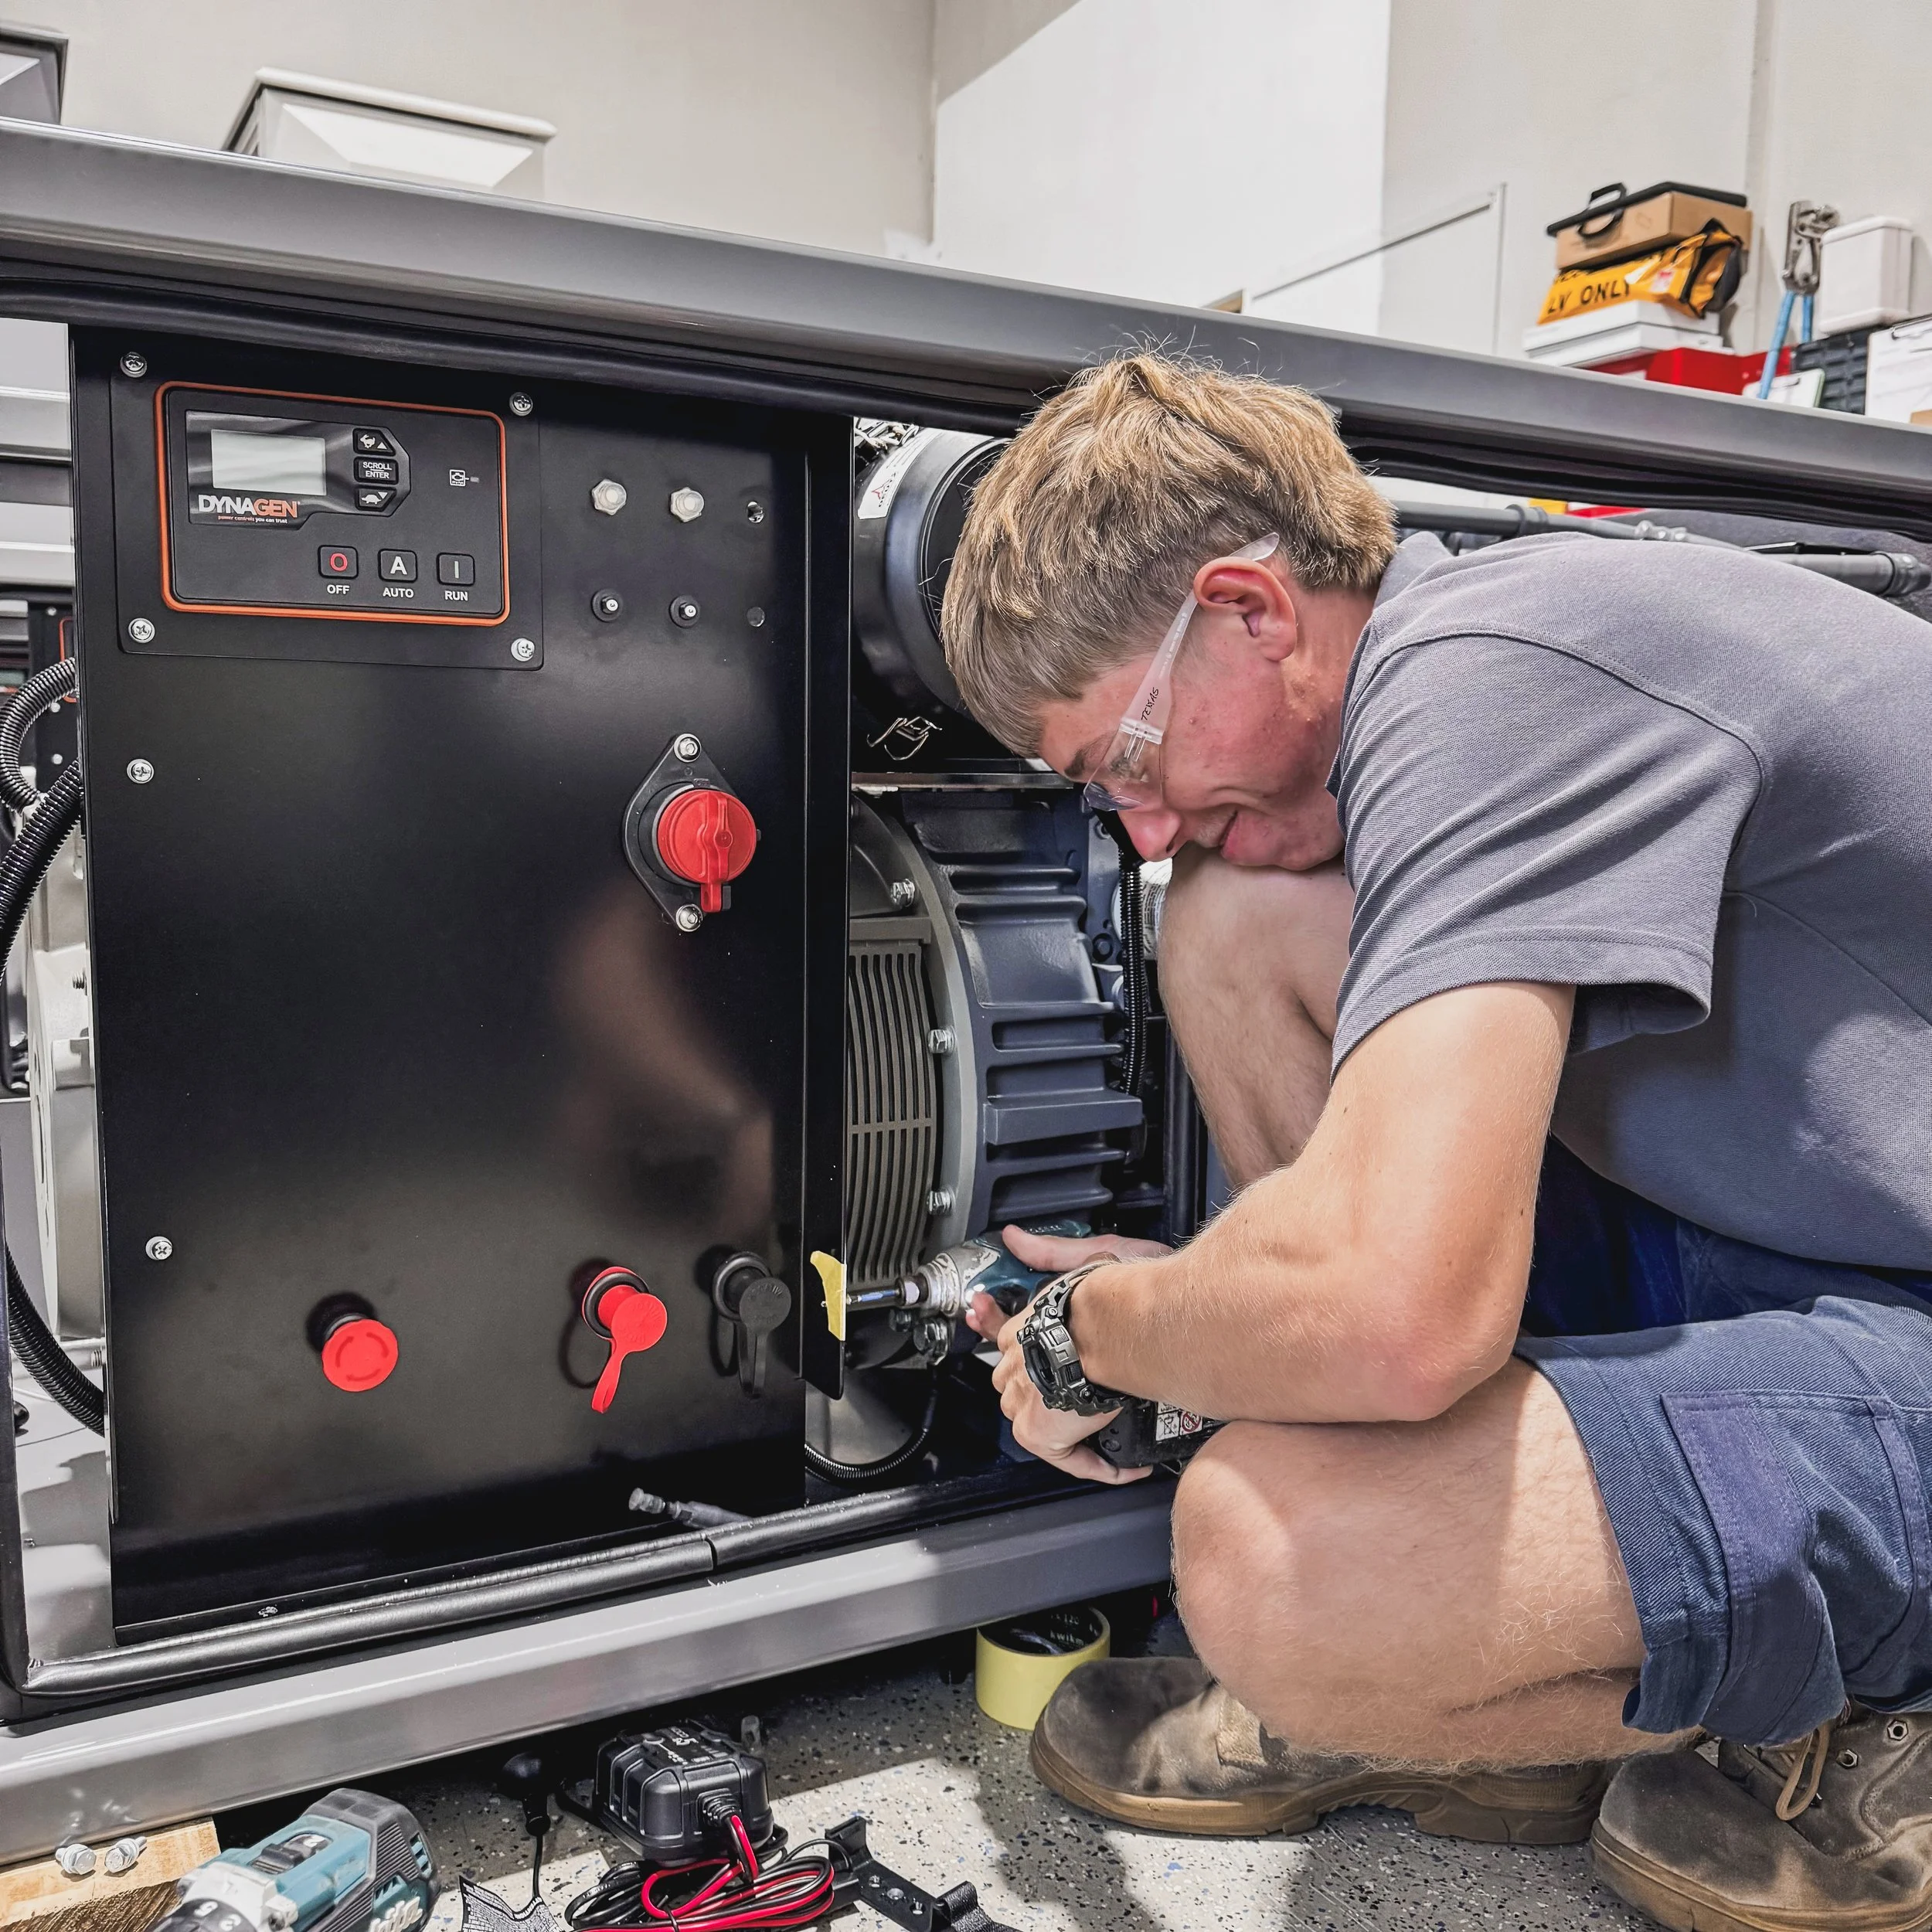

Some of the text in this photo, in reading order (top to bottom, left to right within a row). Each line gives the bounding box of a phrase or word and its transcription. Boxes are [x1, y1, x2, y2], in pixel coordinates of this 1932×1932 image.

[362, 461, 393, 471] SCROLL
[366, 470, 389, 479] ENTER
[389, 556, 408, 575] A
[326, 584, 350, 594] OFF
[383, 587, 414, 598] AUTO
[444, 590, 468, 601] RUN
